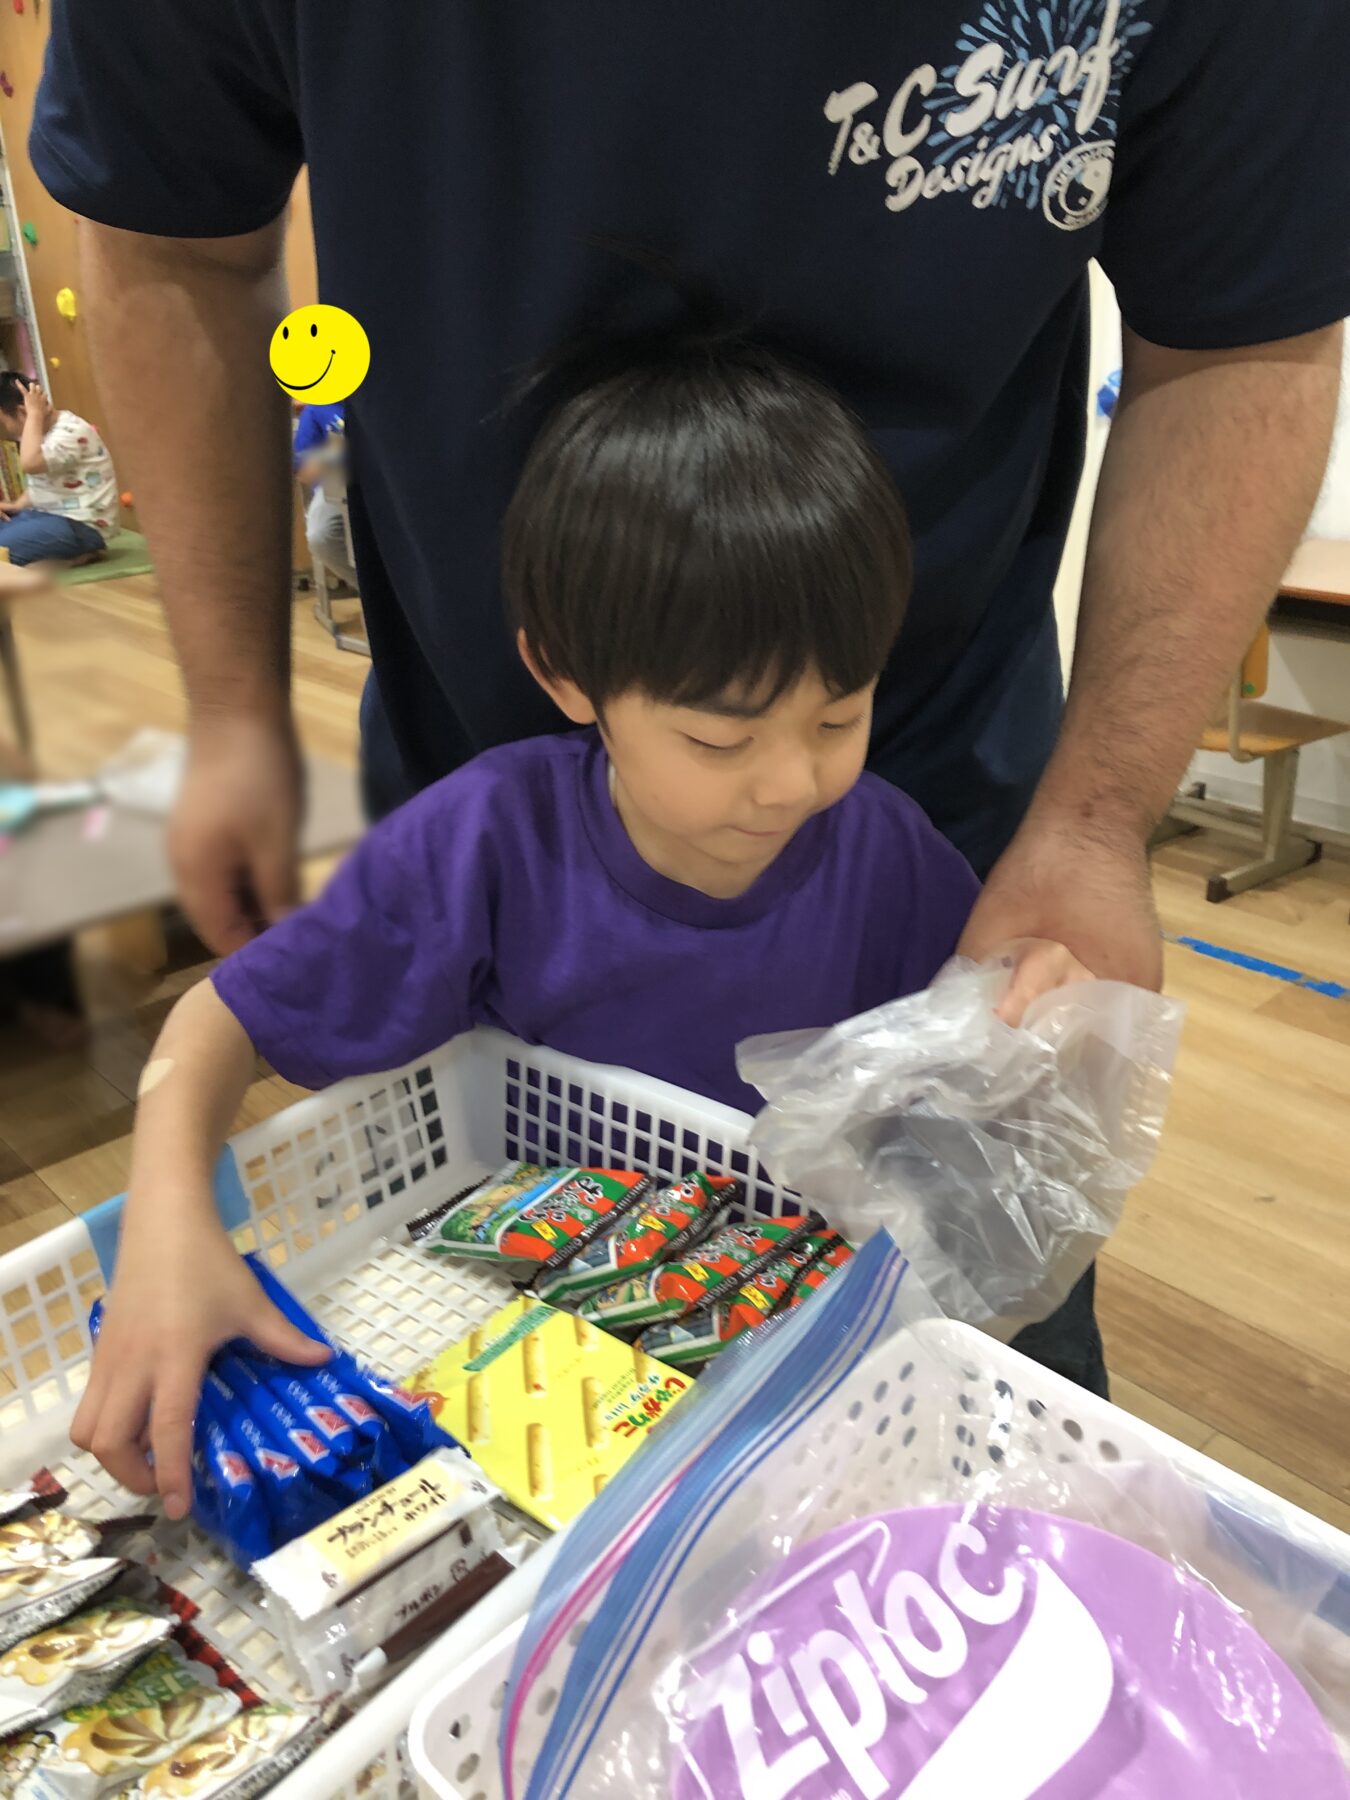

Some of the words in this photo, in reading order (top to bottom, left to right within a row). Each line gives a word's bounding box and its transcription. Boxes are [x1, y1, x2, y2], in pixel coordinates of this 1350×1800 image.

[945, 0, 1122, 137] Surf
[884, 122, 1061, 212] Designs
[612, 1376, 687, 1438] じゃがりこ
[678, 1521, 1026, 1800] Ziploc
